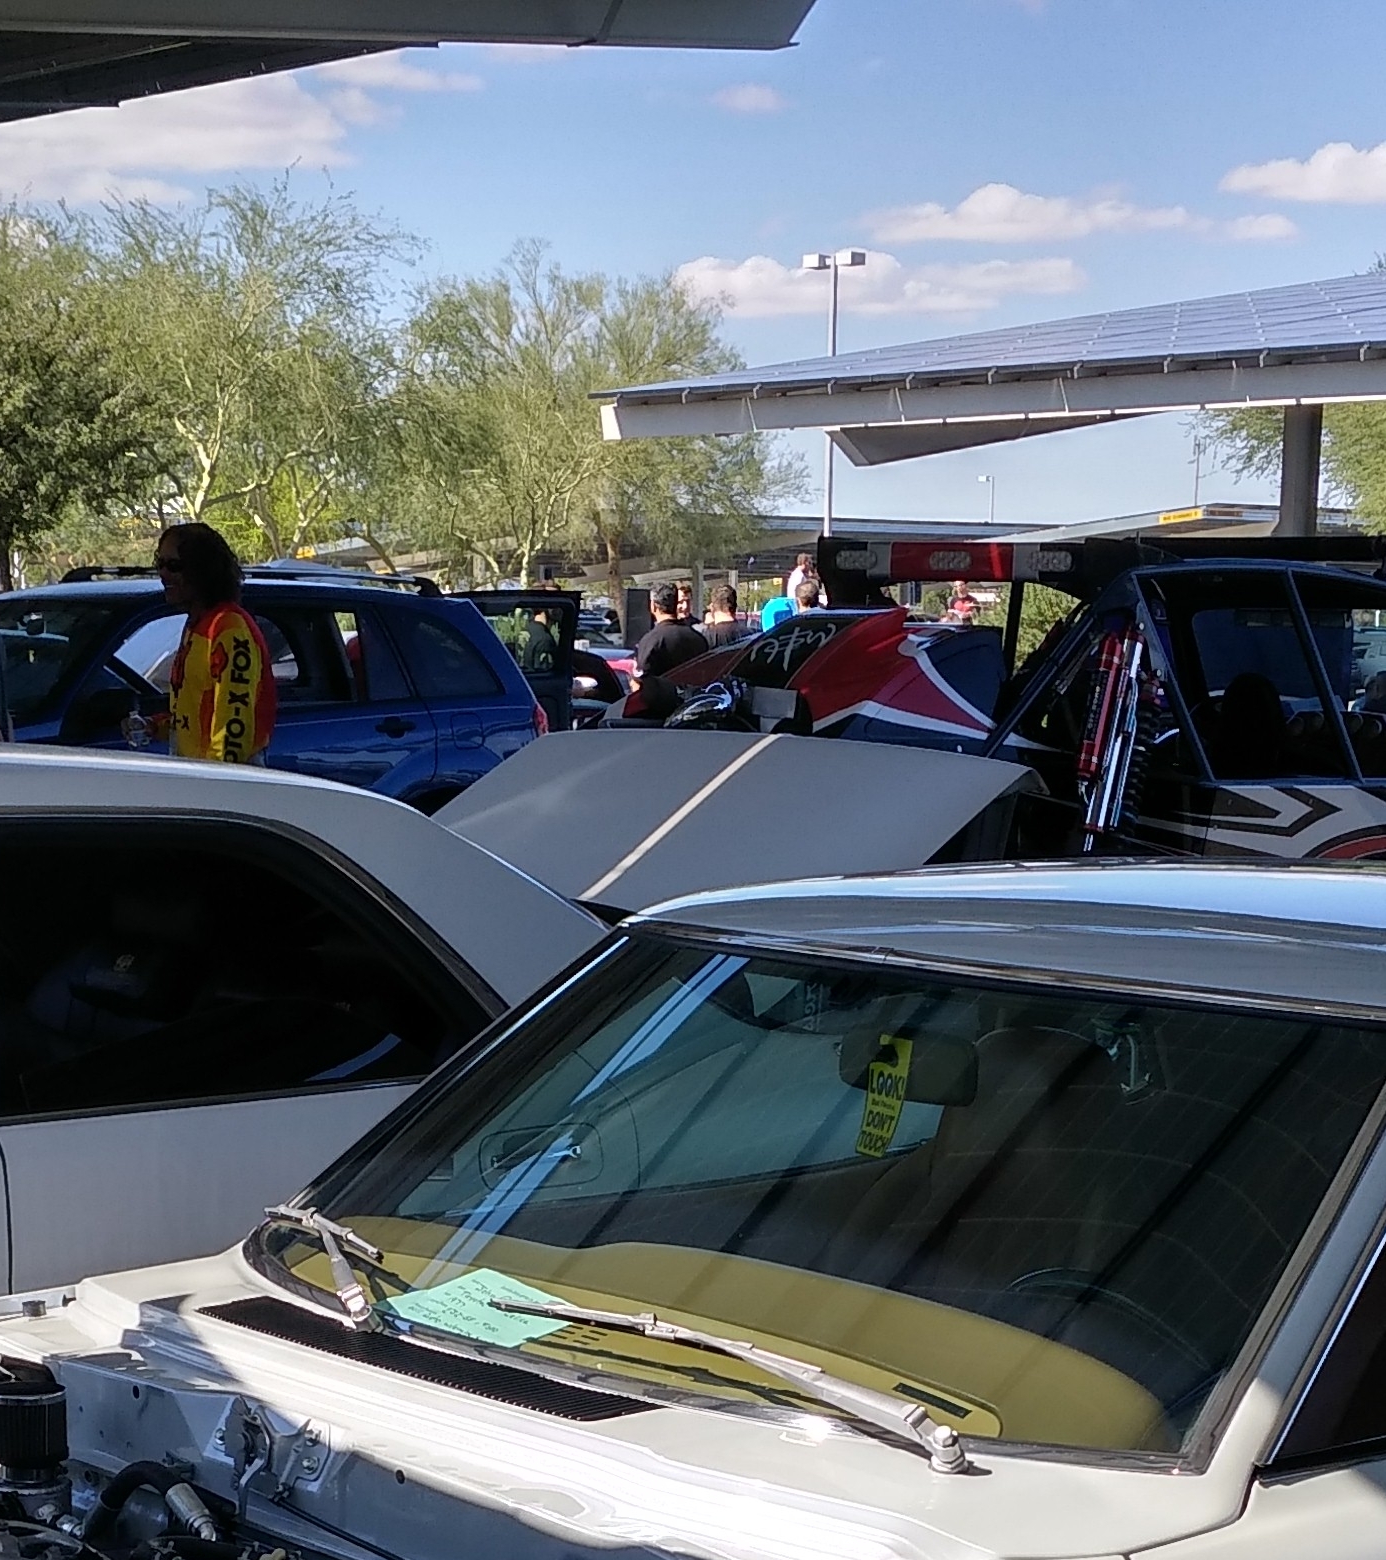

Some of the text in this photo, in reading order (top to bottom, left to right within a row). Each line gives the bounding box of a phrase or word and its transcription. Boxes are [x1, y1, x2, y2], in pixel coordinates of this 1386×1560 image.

[230, 636, 251, 685] FOX
[870, 1069, 904, 1100] LOOK!
[865, 1110, 895, 1133] DON'T
